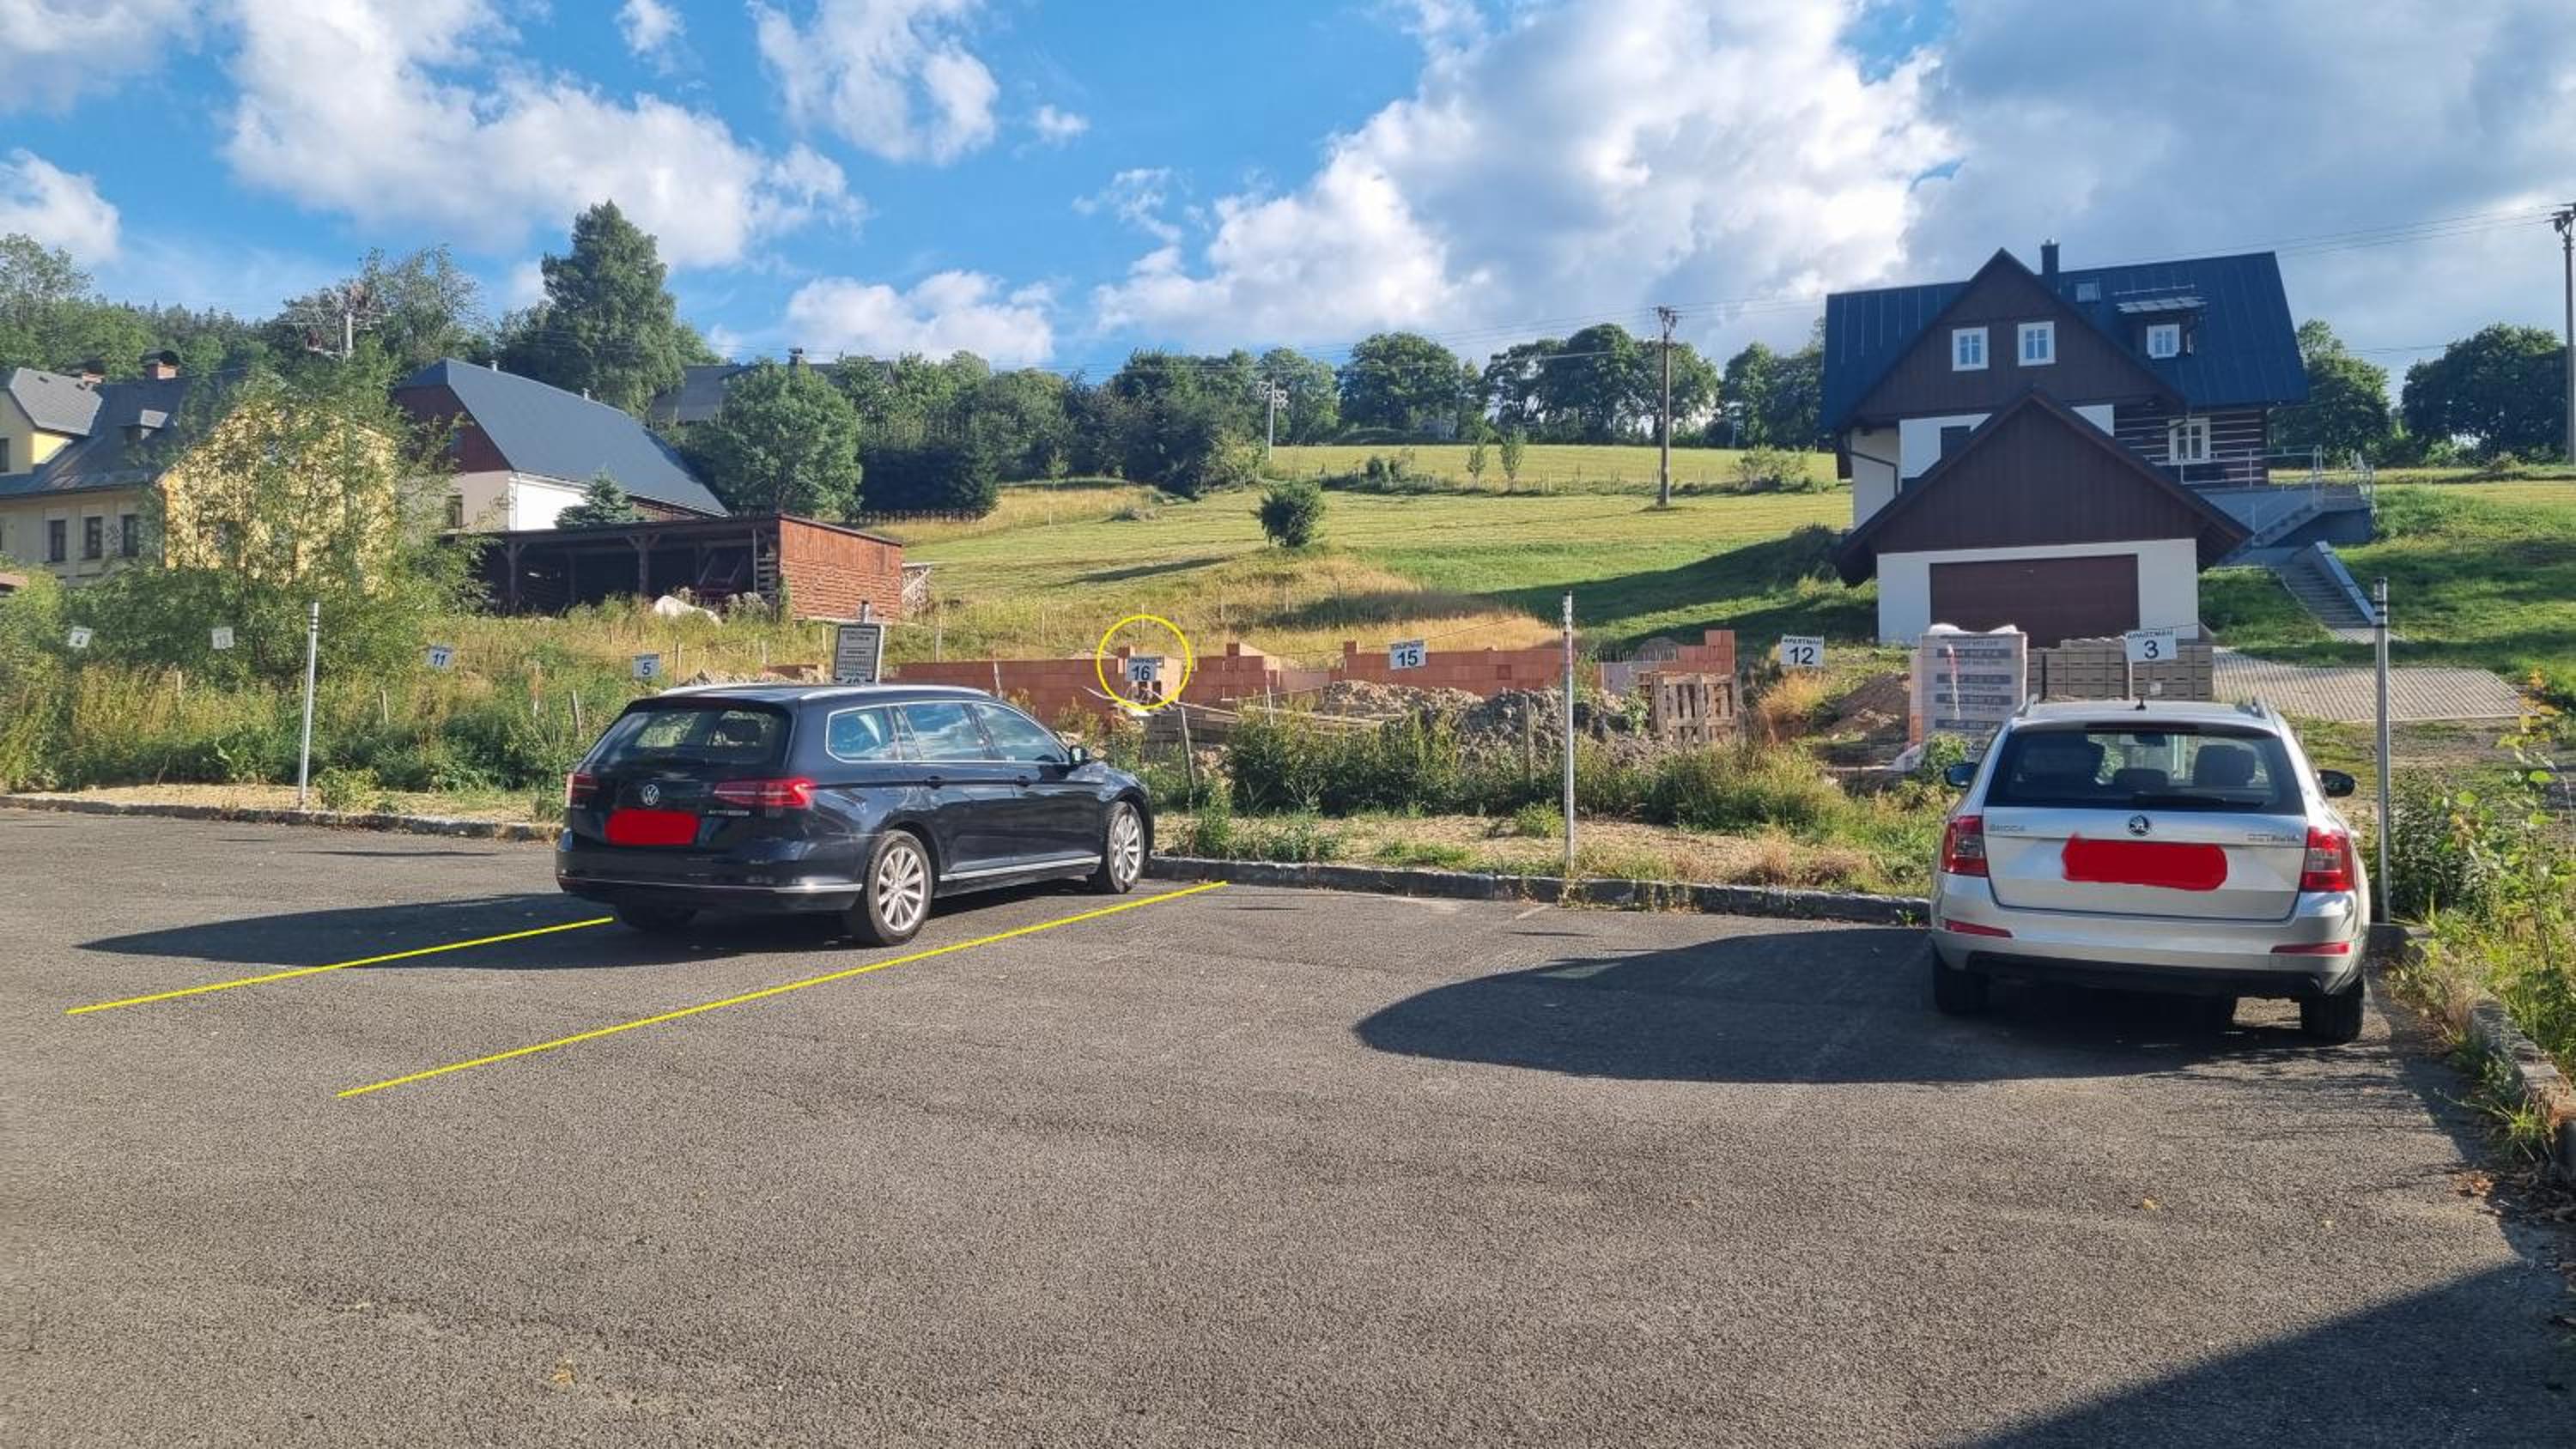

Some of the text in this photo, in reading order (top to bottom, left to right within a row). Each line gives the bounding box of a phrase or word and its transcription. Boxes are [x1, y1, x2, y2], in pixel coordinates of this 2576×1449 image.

[1789, 646, 1814, 664] 12
[2144, 640, 2159, 658] 3
[1397, 650, 1418, 666] 15
[642, 662, 651, 675] 5
[1132, 665, 1151, 680] 16
